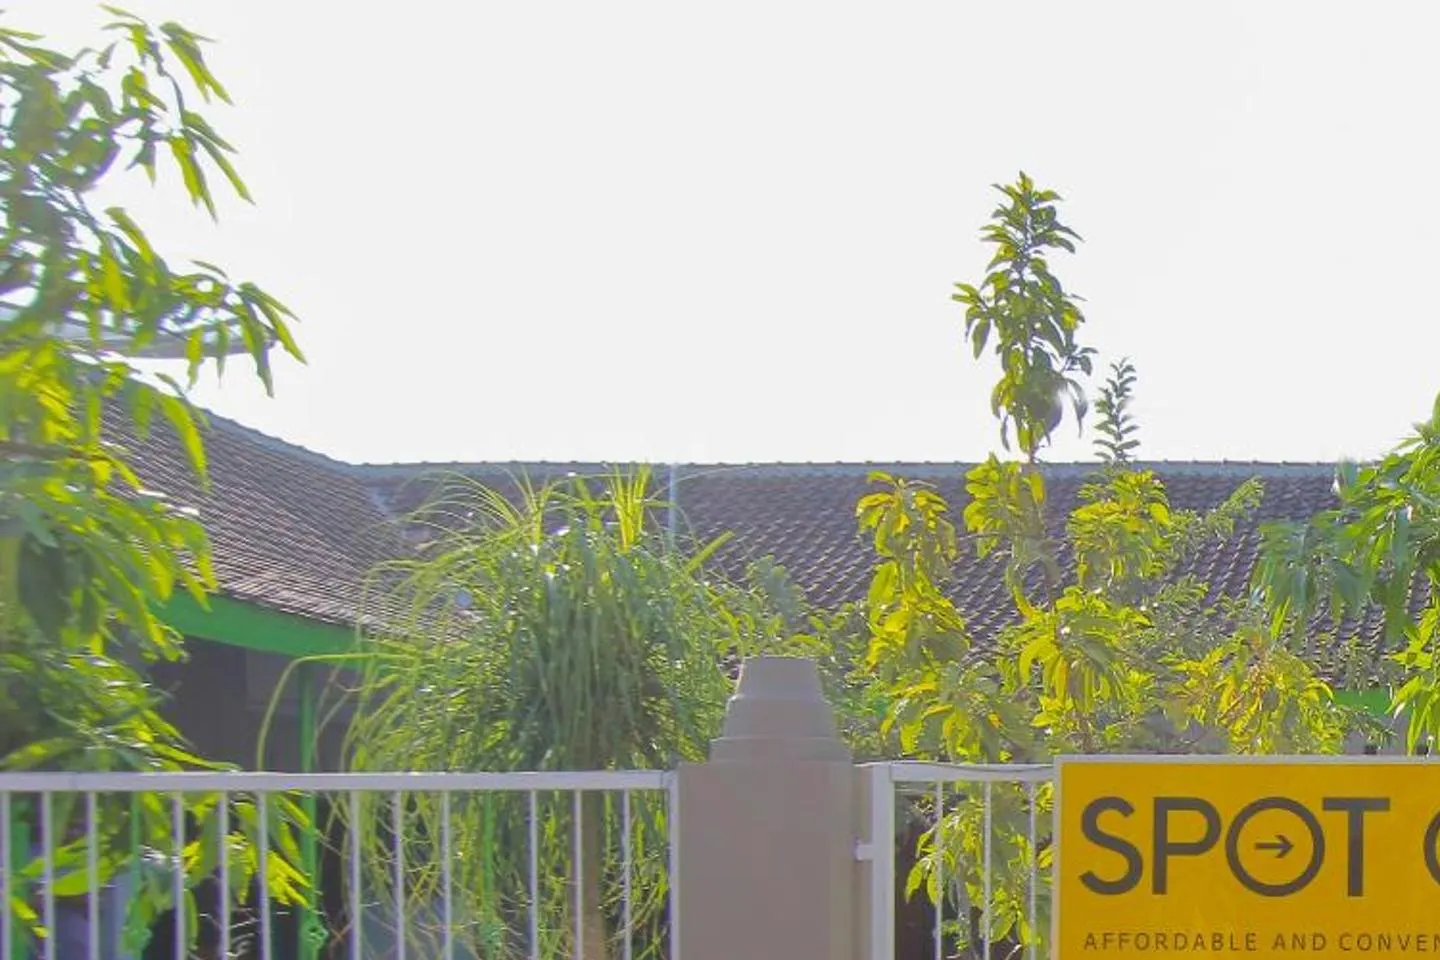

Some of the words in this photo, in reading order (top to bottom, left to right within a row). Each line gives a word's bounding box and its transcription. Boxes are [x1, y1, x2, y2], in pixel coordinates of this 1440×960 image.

[1078, 796, 1390, 897] SPOT
[1083, 931, 1259, 953] AFFORDABLE
[1271, 931, 1328, 953] AND
